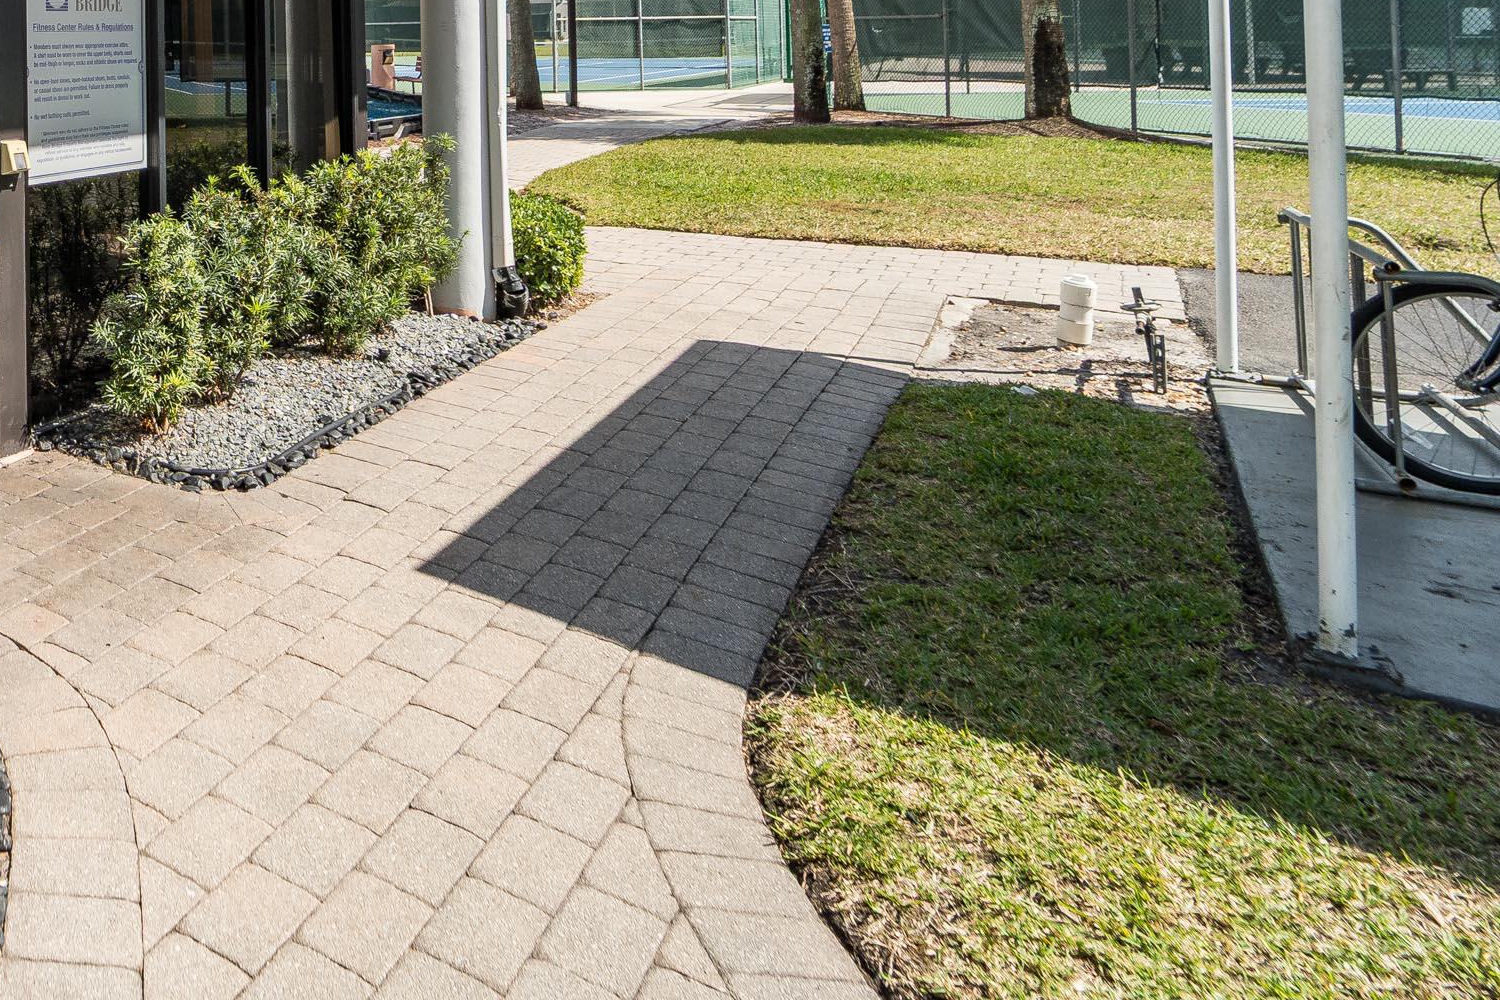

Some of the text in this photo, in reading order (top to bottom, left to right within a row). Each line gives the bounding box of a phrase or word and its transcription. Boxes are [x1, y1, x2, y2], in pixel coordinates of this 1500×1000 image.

[32, 23, 133, 32] Fitness Center Rules & Regulations
